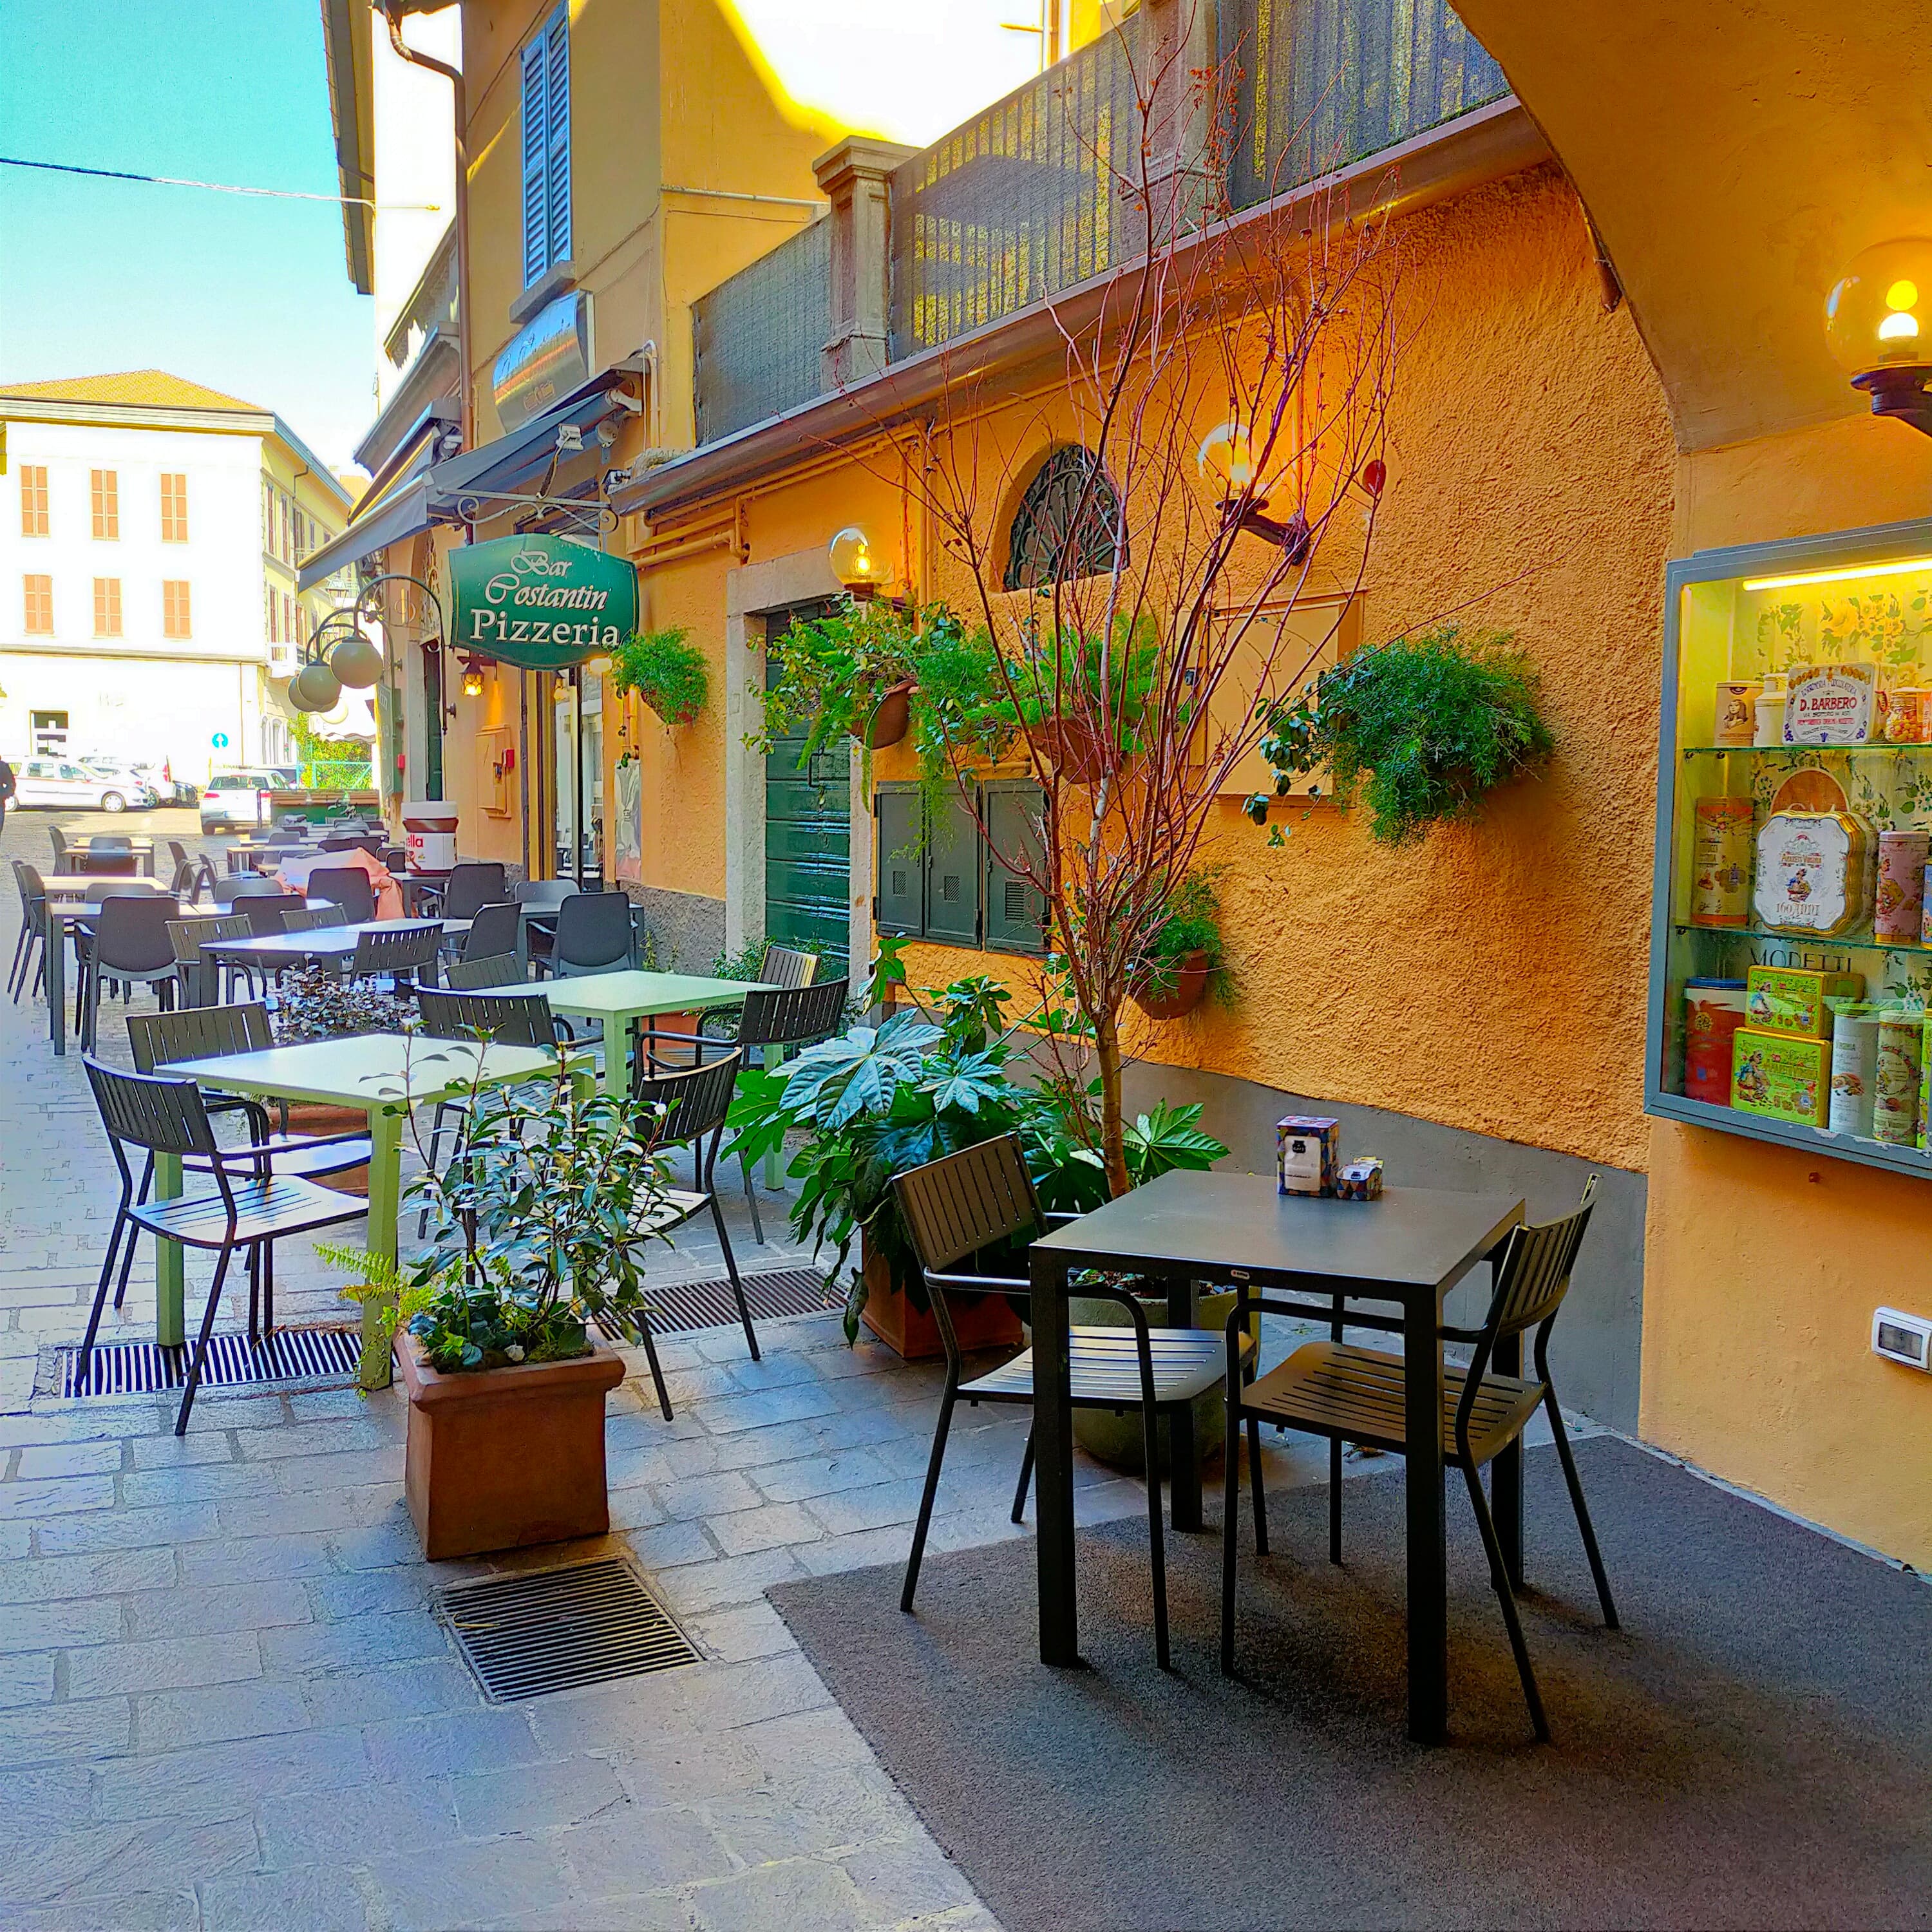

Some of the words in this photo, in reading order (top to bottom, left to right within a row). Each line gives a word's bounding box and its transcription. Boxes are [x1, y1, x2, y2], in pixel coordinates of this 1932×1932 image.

[510, 549, 573, 576] Bar
[485, 573, 609, 611] Costantin
[469, 609, 620, 646] Pizzeria
[1811, 697, 1857, 710] BARBERO
[406, 834, 424, 848] ella
